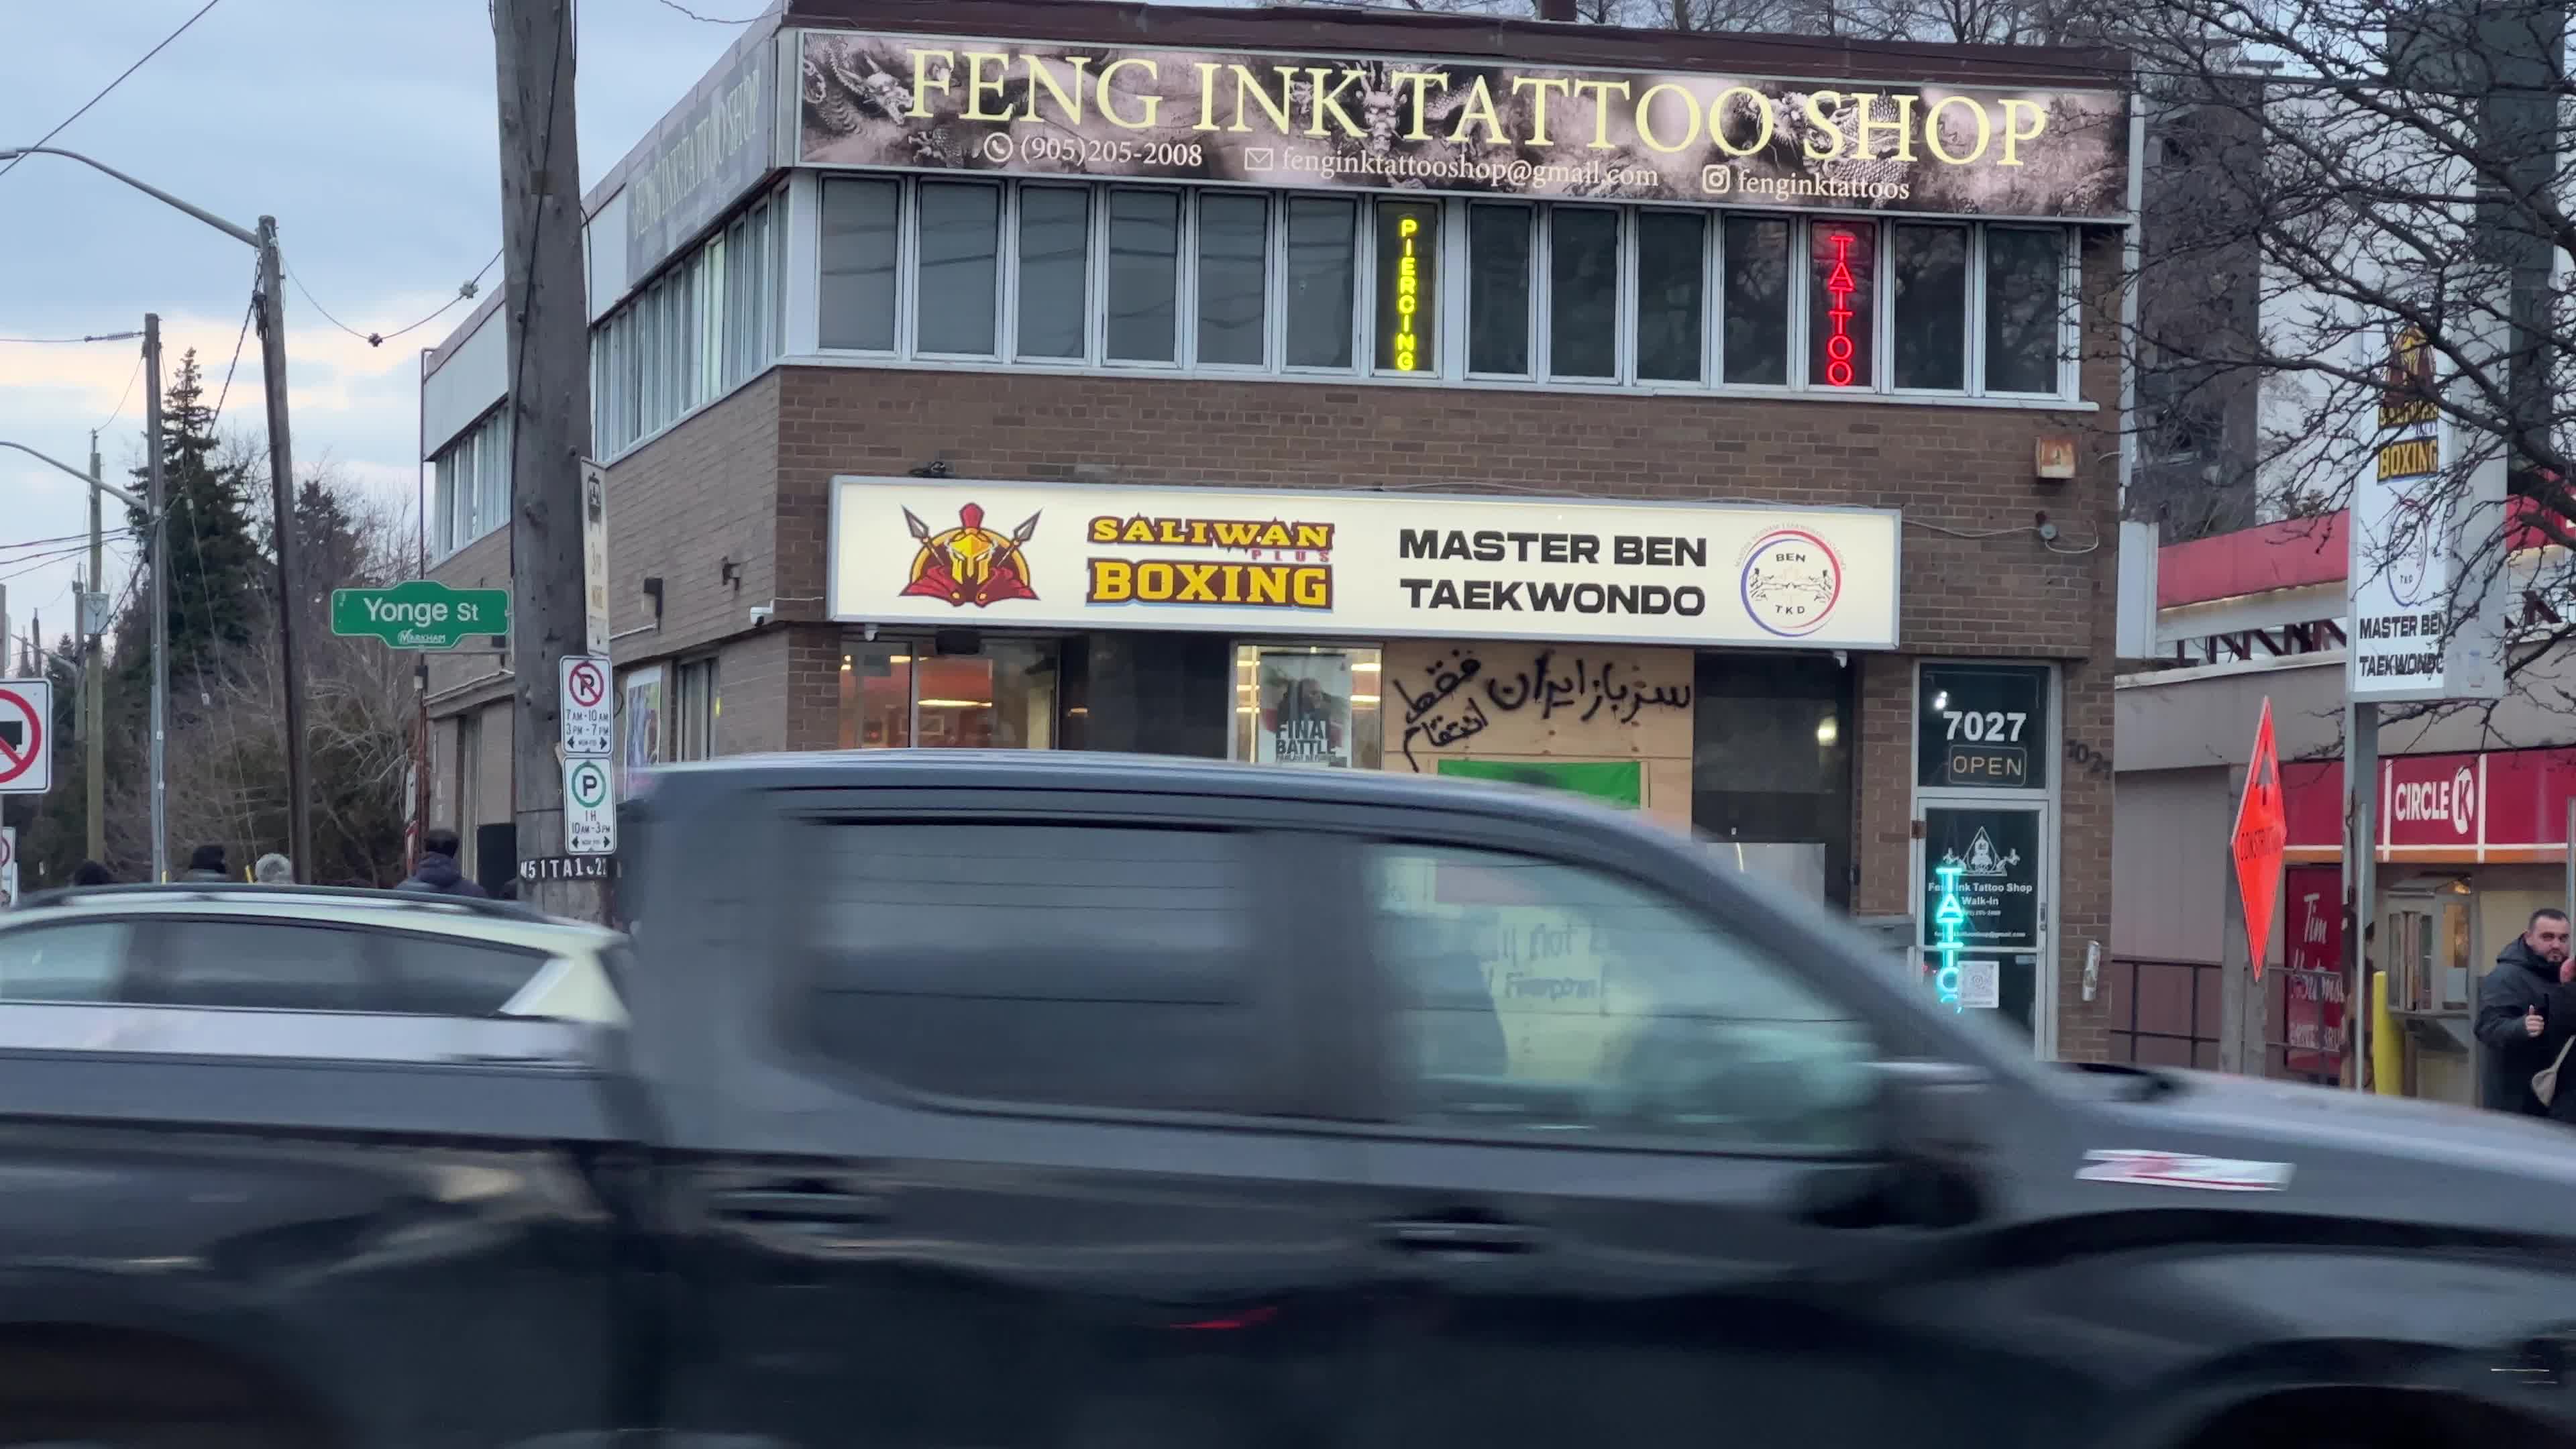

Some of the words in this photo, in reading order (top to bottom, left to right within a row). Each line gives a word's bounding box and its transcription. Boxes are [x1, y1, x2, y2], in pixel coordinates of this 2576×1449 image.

[904, 49, 1163, 129] FENG
[1192, 62, 1368, 138] INK
[1391, 70, 1773, 156] TATTOO
[1803, 90, 2046, 166] SHOP
[1020, 135, 1203, 166] (905)205-2008
[1282, 147, 1659, 188] fenginktattooshop@gmail.com
[1737, 169, 1911, 201] fenginktattoos
[1397, 219, 1417, 371] PIERCING
[1828, 236, 1855, 386] TATTOO
[2379, 440, 2437, 480] BOXING
[1093, 518, 1330, 547] SALIWAN
[1399, 529, 1601, 564] MASTER
[1613, 535, 1707, 567] BEN
[1252, 549, 1330, 563] PLUS
[1776, 553, 1806, 563] BEN
[1093, 561, 1328, 606] BOXING
[1399, 578, 1706, 616] TAEKWONDO
[363, 597, 448, 627] Yonge
[457, 602, 480, 621] St
[2360, 615, 2418, 639] MASTER
[1943, 711, 2027, 742] 7027
[1953, 755, 2022, 775] OPEN
[2395, 782, 2449, 821] CIRCLE
[1974, 883, 2004, 892] Tattoo
[2006, 883, 2033, 894] Shop
[2304, 893, 2327, 945] Tim
